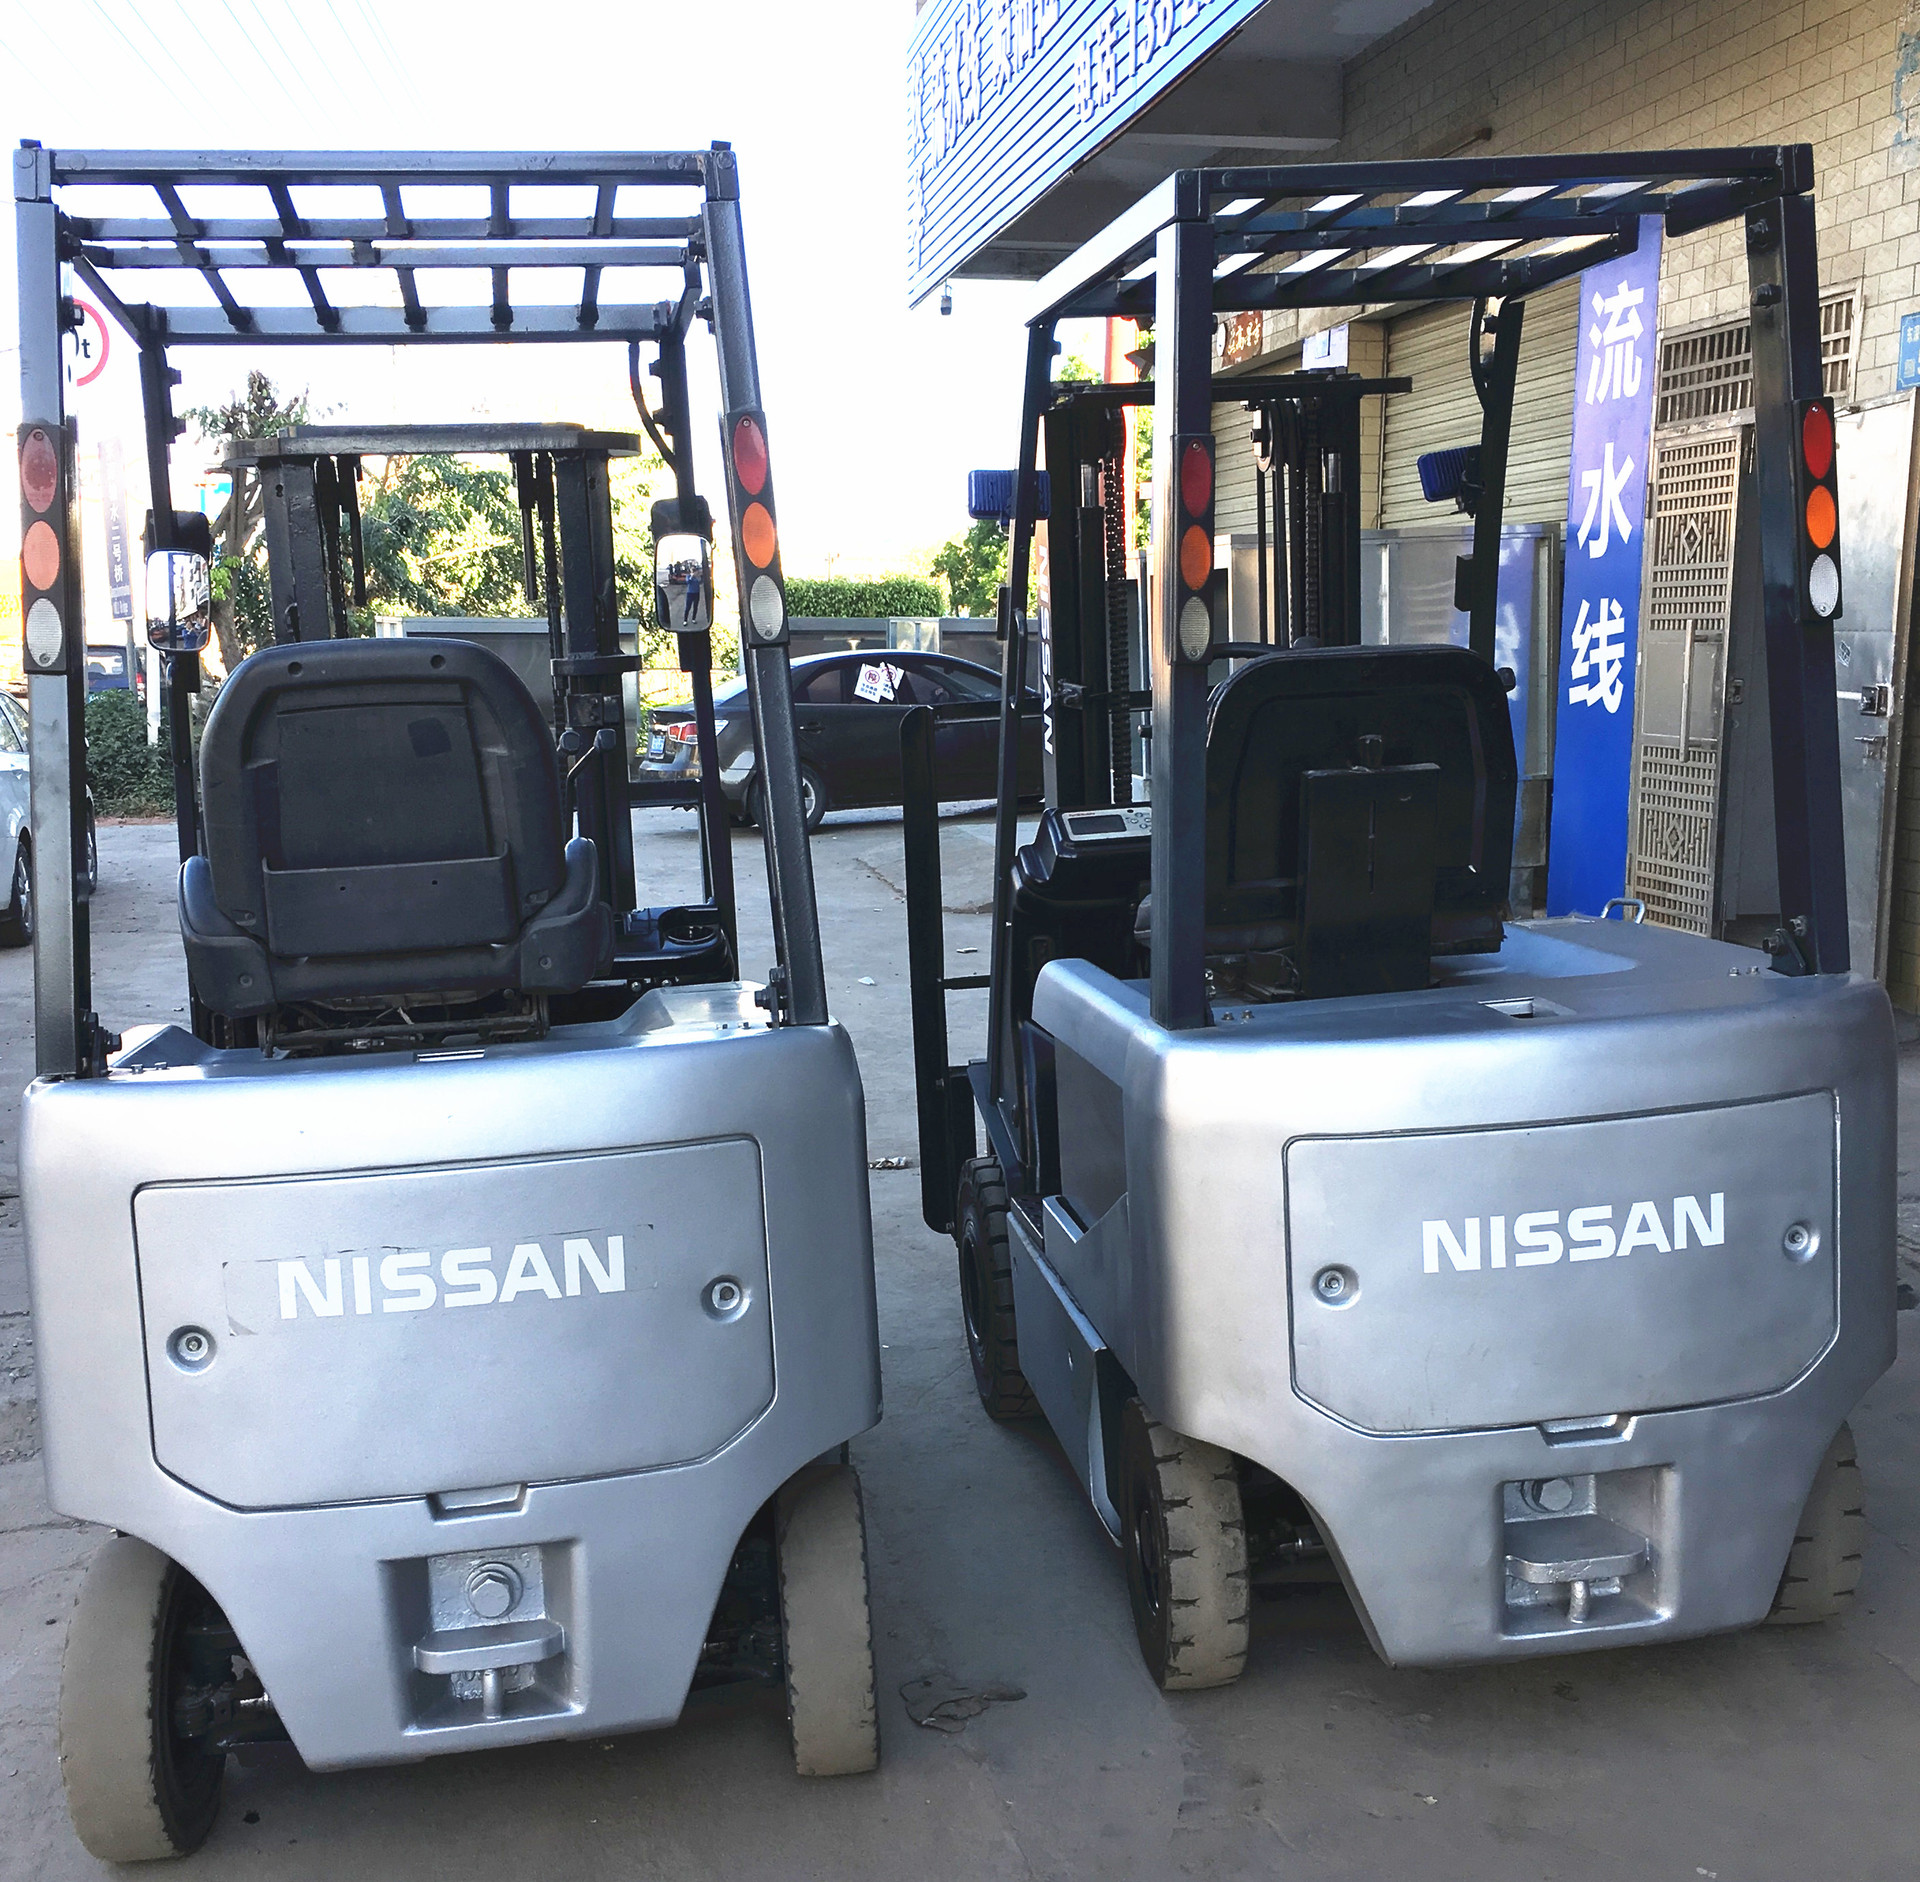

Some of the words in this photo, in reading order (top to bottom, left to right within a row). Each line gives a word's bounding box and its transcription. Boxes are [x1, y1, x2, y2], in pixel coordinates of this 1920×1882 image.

[1568, 279, 1646, 714] 流水线
[1038, 544, 1055, 755] NISSAN
[277, 1235, 626, 1320] NISSAN
[1422, 1192, 1725, 1274] NISSAN
